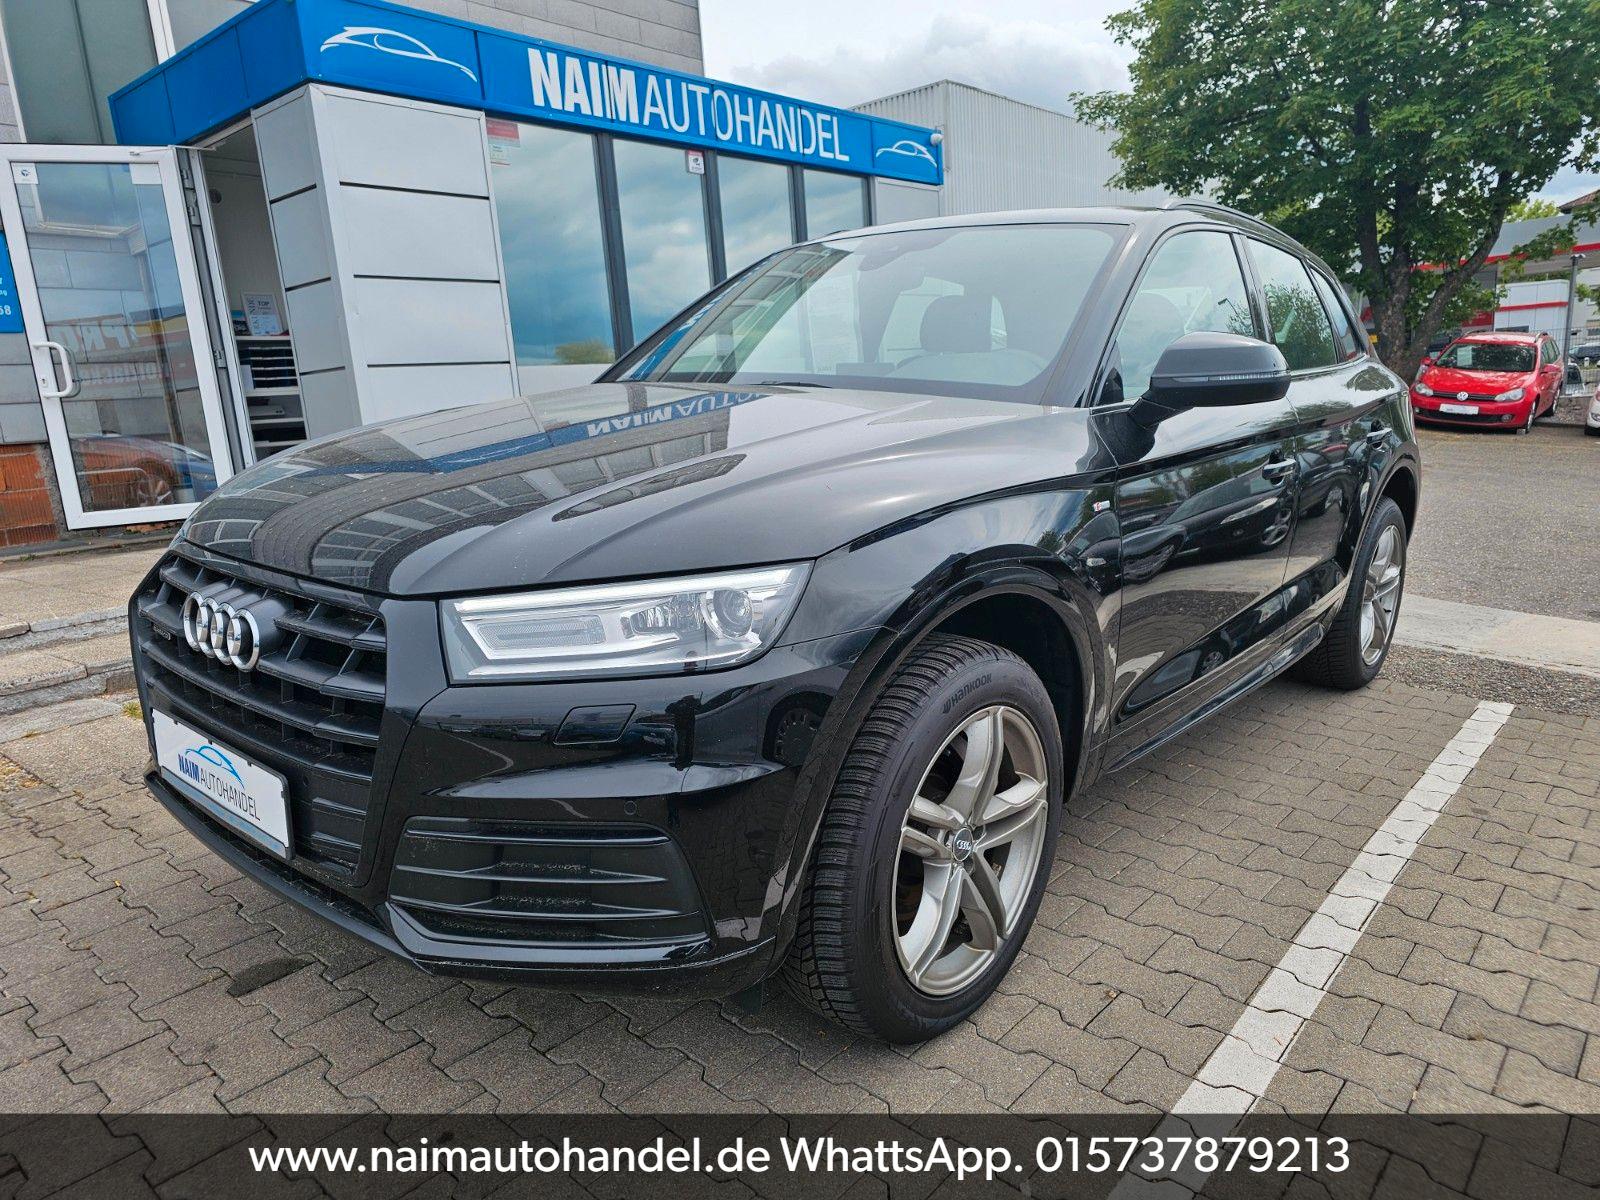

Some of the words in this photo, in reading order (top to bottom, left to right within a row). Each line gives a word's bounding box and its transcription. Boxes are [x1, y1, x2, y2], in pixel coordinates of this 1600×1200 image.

[527, 47, 640, 125] NAIM
[642, 74, 850, 163] AUTOHANDEL
[178, 753, 200, 784] NAIM
[200, 767, 261, 822] AUTOHANDEL
